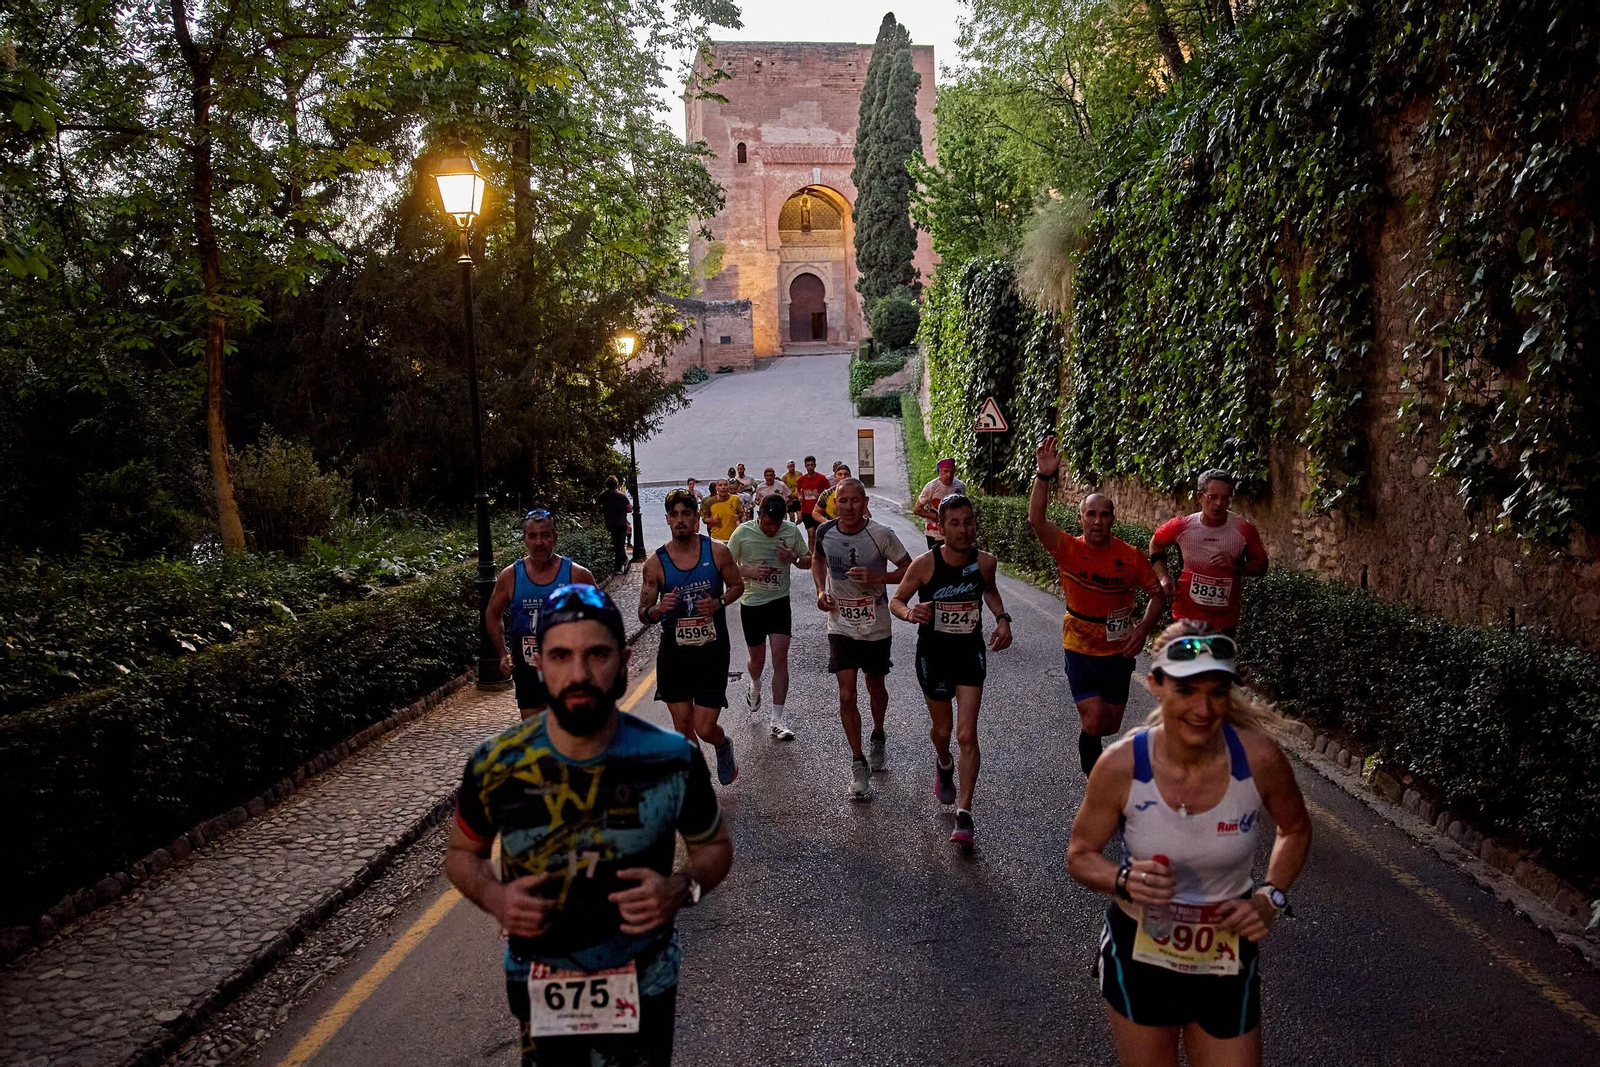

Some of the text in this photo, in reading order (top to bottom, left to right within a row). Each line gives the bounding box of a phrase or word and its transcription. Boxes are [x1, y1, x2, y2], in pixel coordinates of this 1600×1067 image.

[1191, 583, 1226, 598] 3833
[840, 607, 869, 620] 3834
[941, 612, 969, 624] 824
[677, 626, 709, 640] 4596
[1217, 821, 1238, 832] Run
[544, 979, 610, 1011] 675
